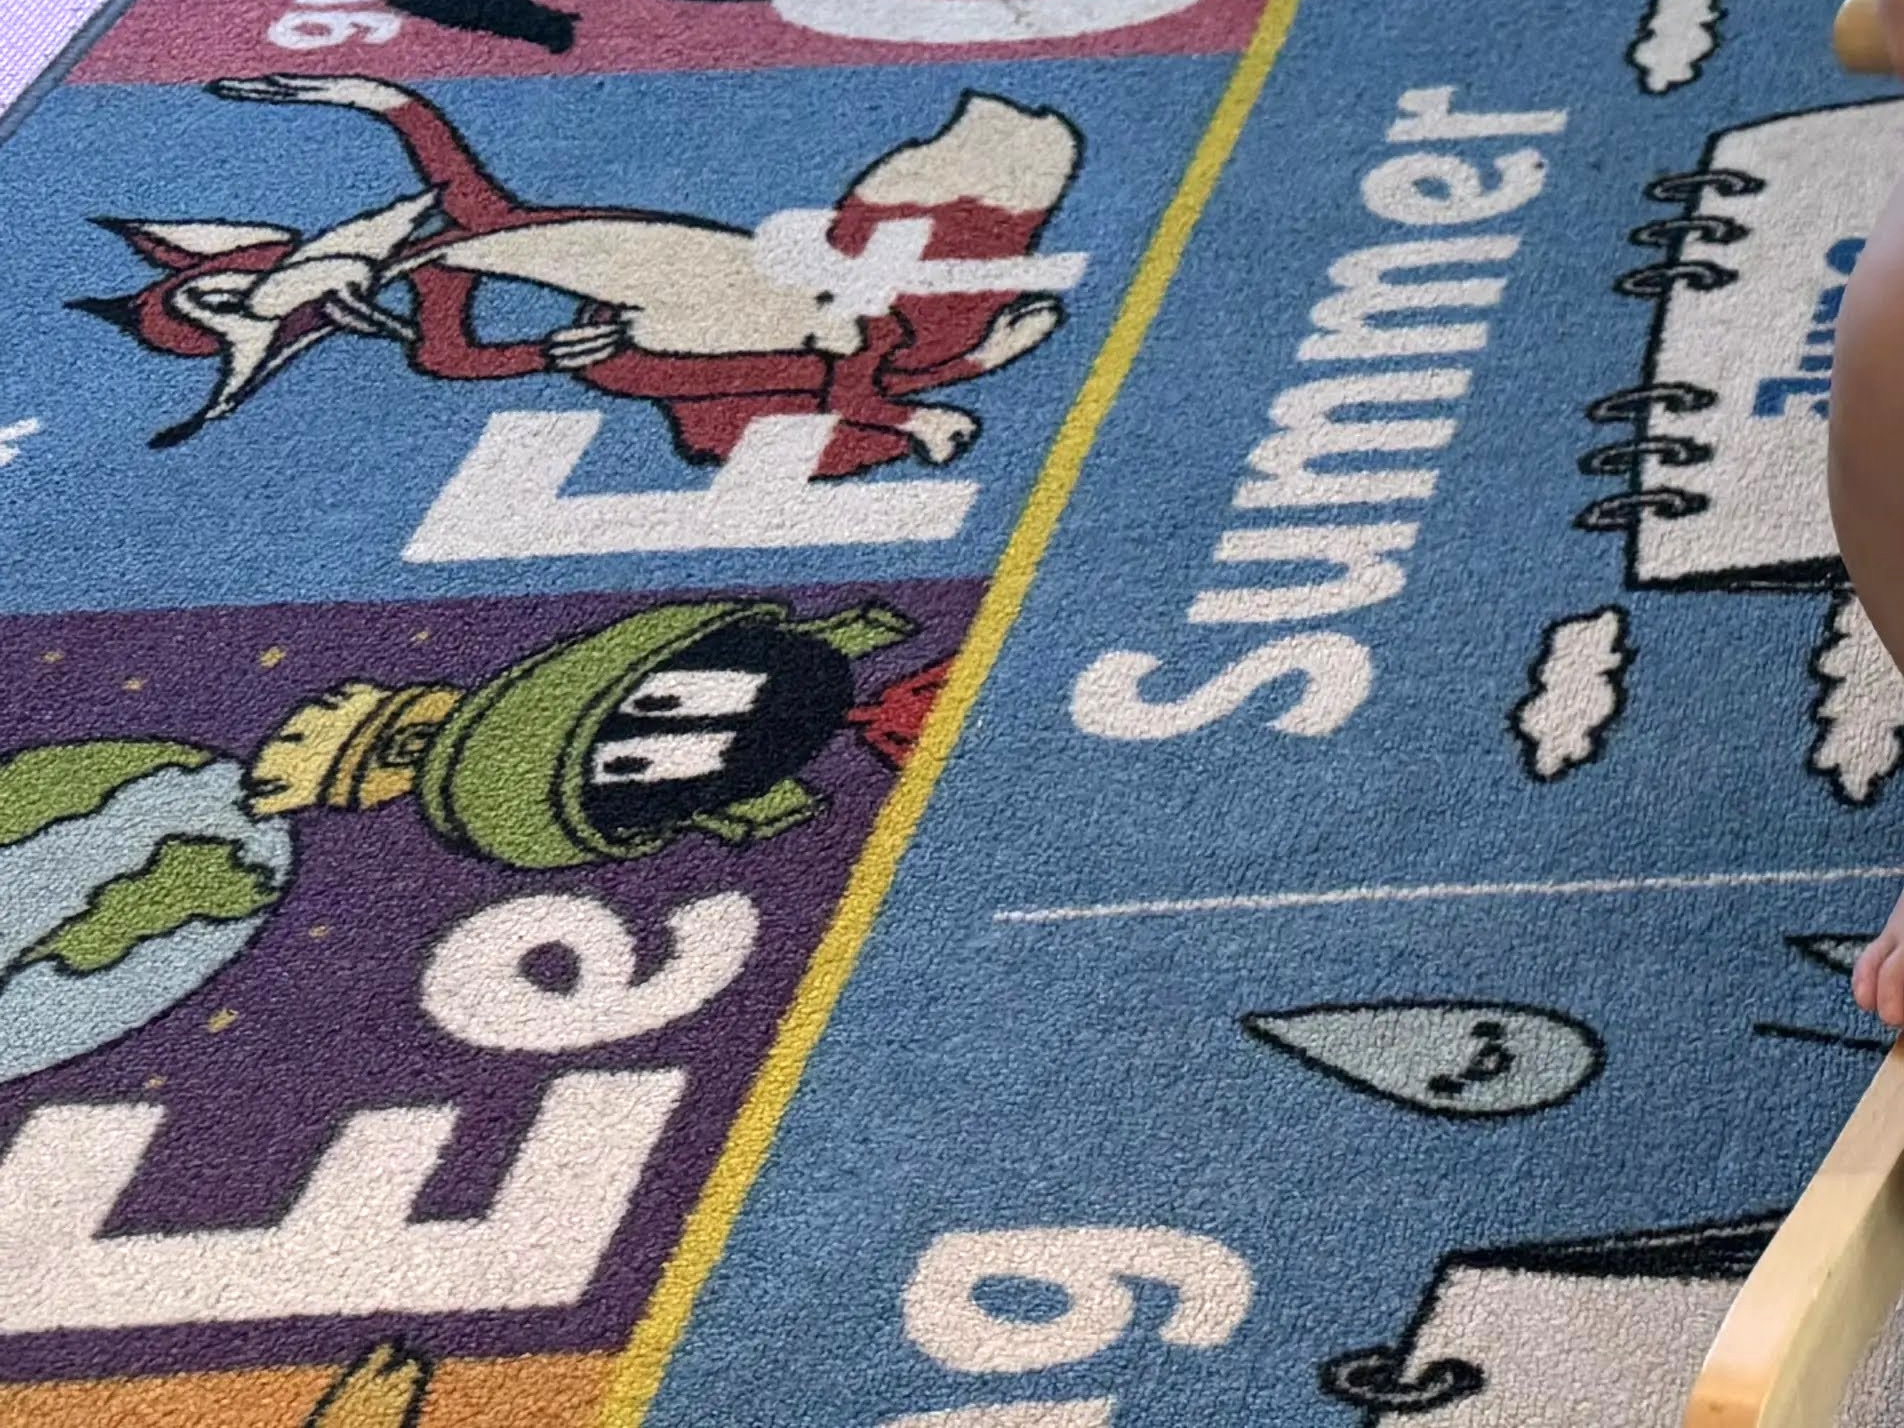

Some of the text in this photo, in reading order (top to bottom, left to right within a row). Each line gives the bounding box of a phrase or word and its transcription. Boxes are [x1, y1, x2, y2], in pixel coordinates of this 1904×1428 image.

[403, 207, 1088, 564] Ff
[1068, 83, 1569, 742] Summer
[0, 888, 760, 1335] Ee
